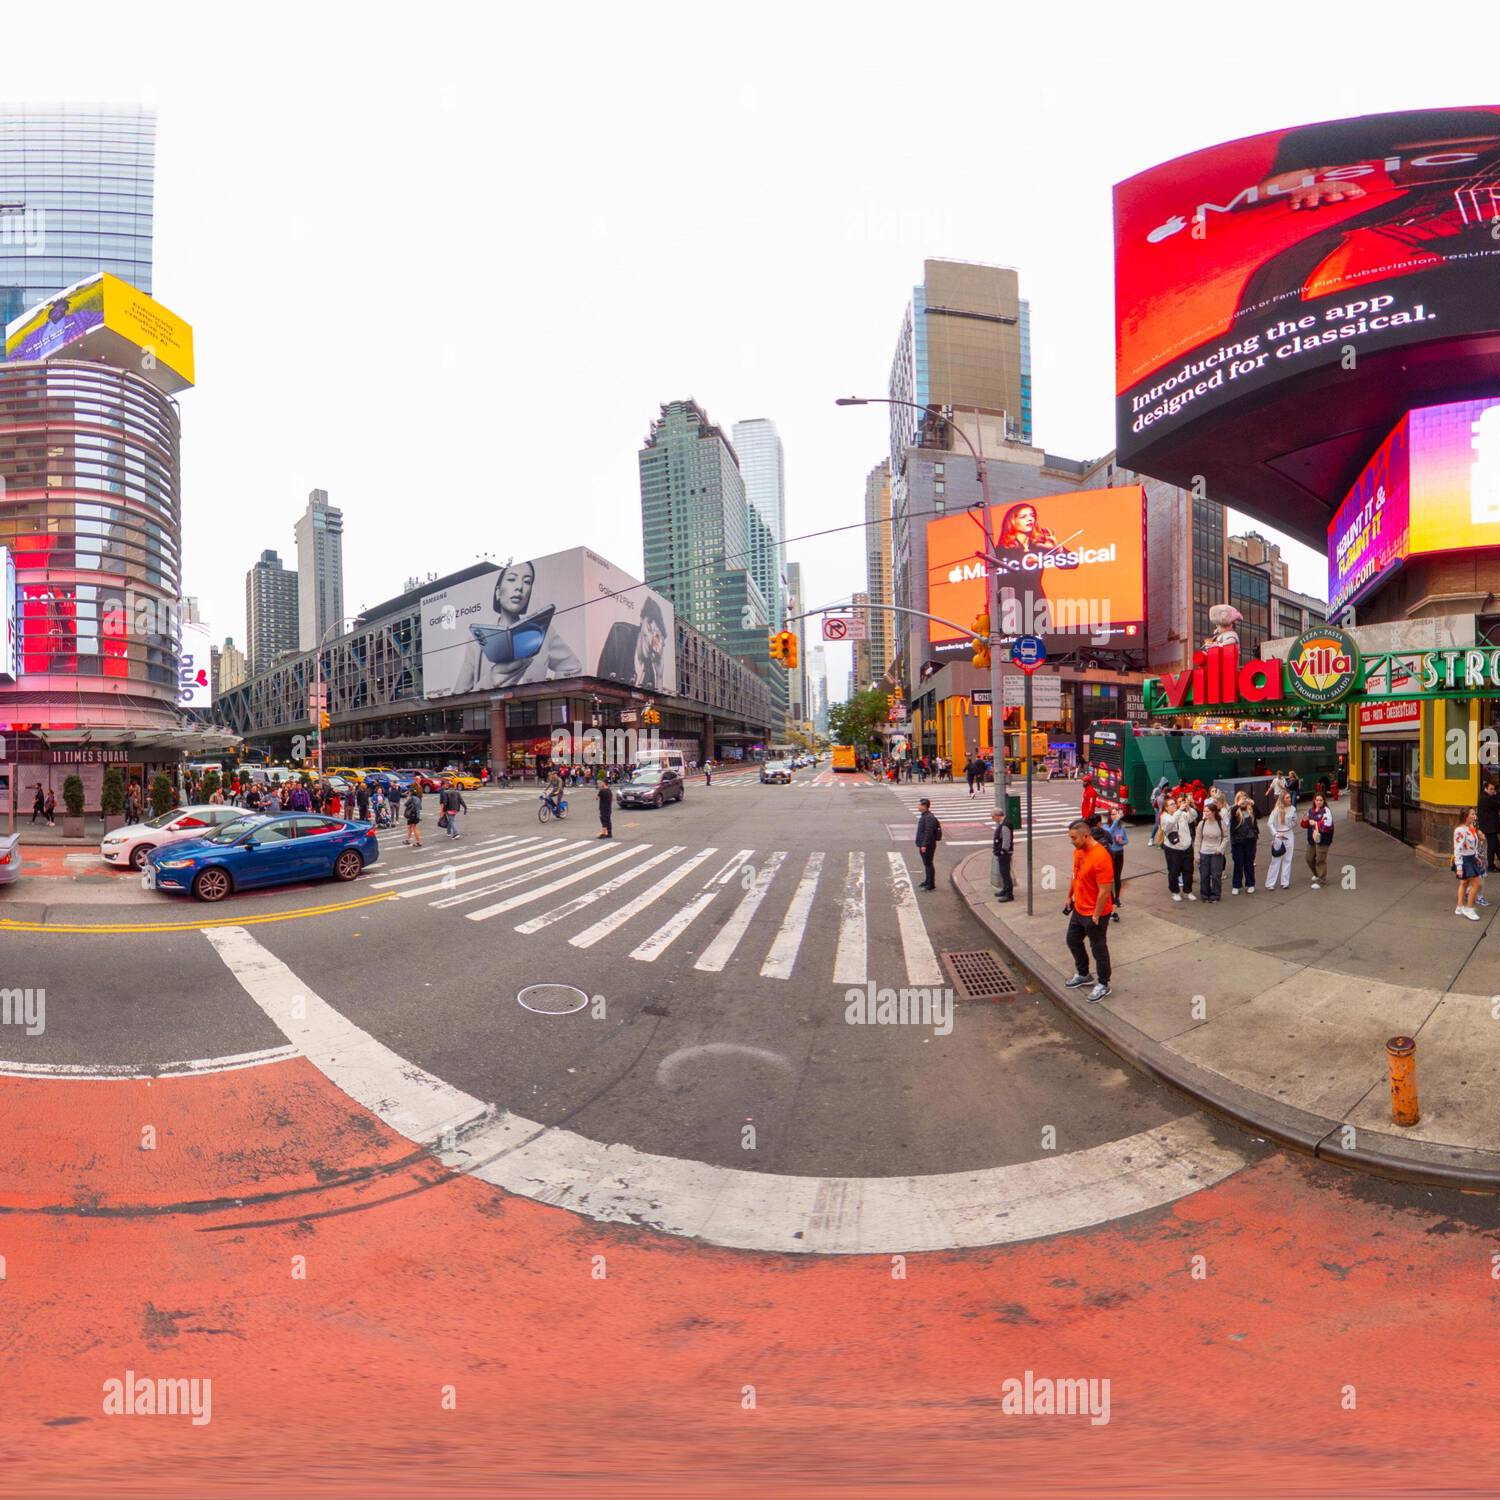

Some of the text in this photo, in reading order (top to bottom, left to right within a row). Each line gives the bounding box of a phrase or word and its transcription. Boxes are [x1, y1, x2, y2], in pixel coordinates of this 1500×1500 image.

[1196, 153, 1478, 220] Music
[1345, 257, 1437, 280] subscription
[1132, 294, 1394, 413] Introducing the app
[1132, 304, 1436, 433] designed for classical.
[1022, 544, 1116, 571] Classical
[422, 592, 448, 606] SAMSUNG
[461, 602, 482, 617] Fold5
[1324, 630, 1343, 641] PASTA
[1160, 643, 1283, 707] villa
[1290, 649, 1352, 678] villa
[1294, 680, 1326, 701] STROMBOLI
[65, 751, 93, 763] TIMES
[97, 750, 128, 762] SQUARE
[1221, 745, 1239, 755] Book,
[1286, 744, 1297, 754] NYC
